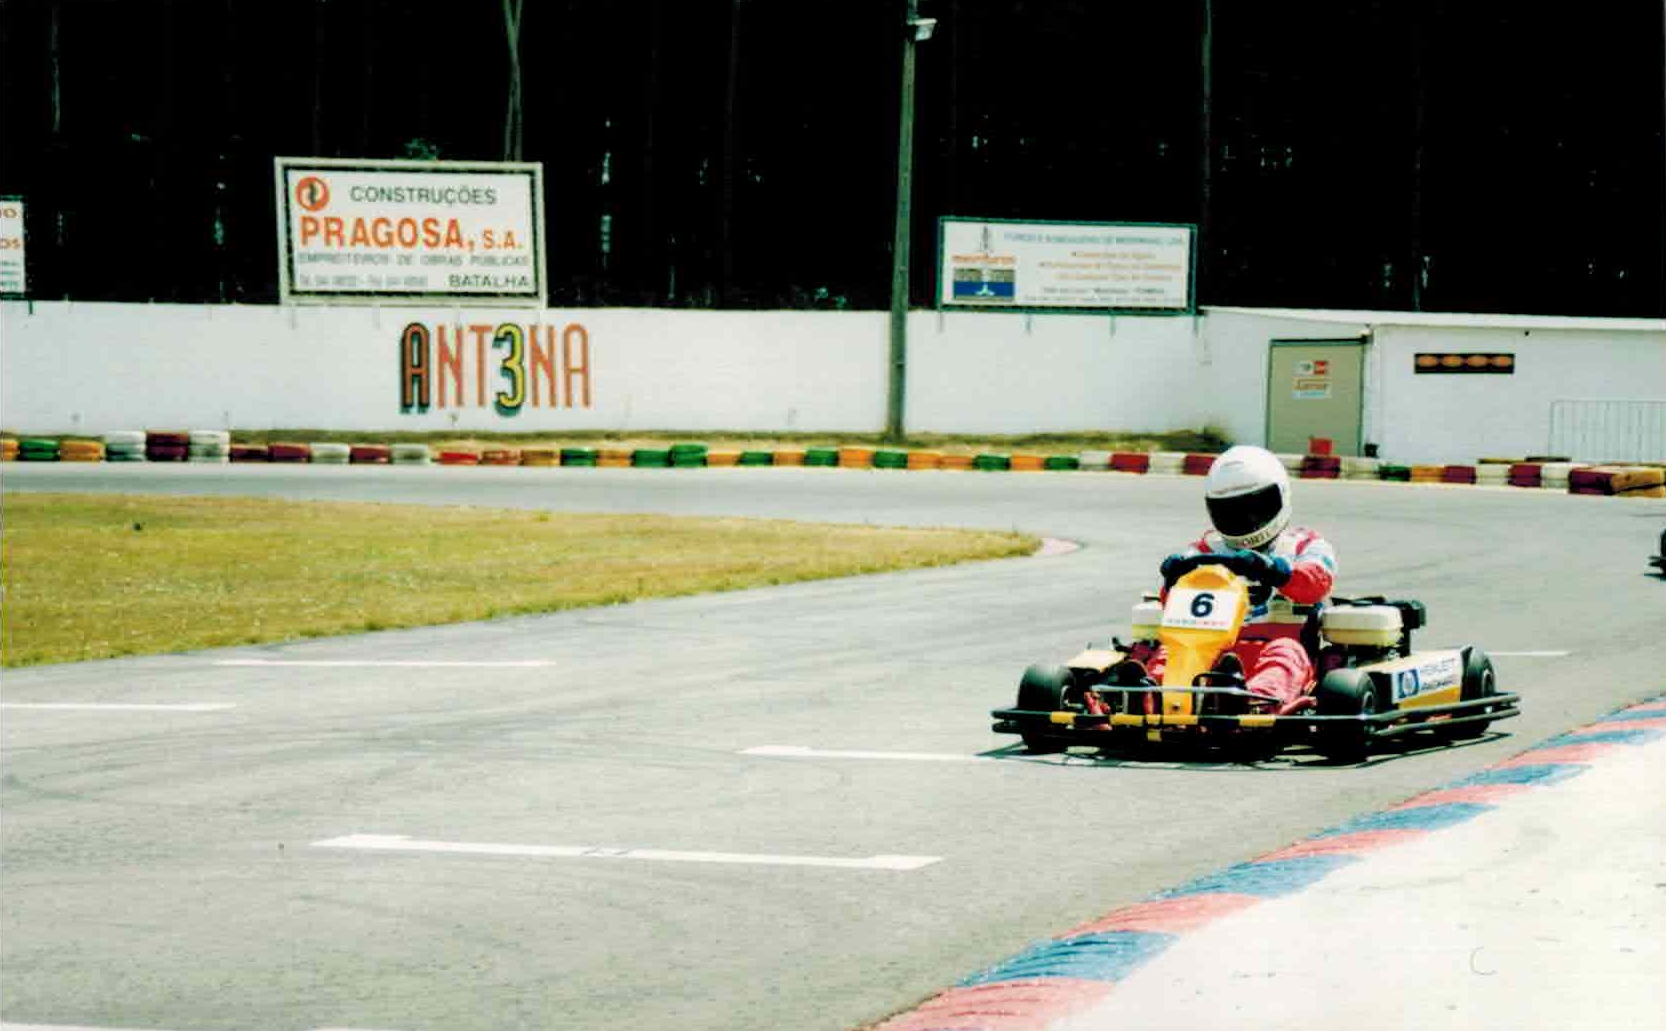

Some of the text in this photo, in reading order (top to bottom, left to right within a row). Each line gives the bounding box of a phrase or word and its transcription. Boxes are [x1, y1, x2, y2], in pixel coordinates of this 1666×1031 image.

[350, 185, 498, 207] CONSTRUÇÕES
[300, 216, 525, 251] PRAGOSA, S.A.
[448, 275, 529, 288] BATALHA
[1190, 592, 1216, 618] 6
